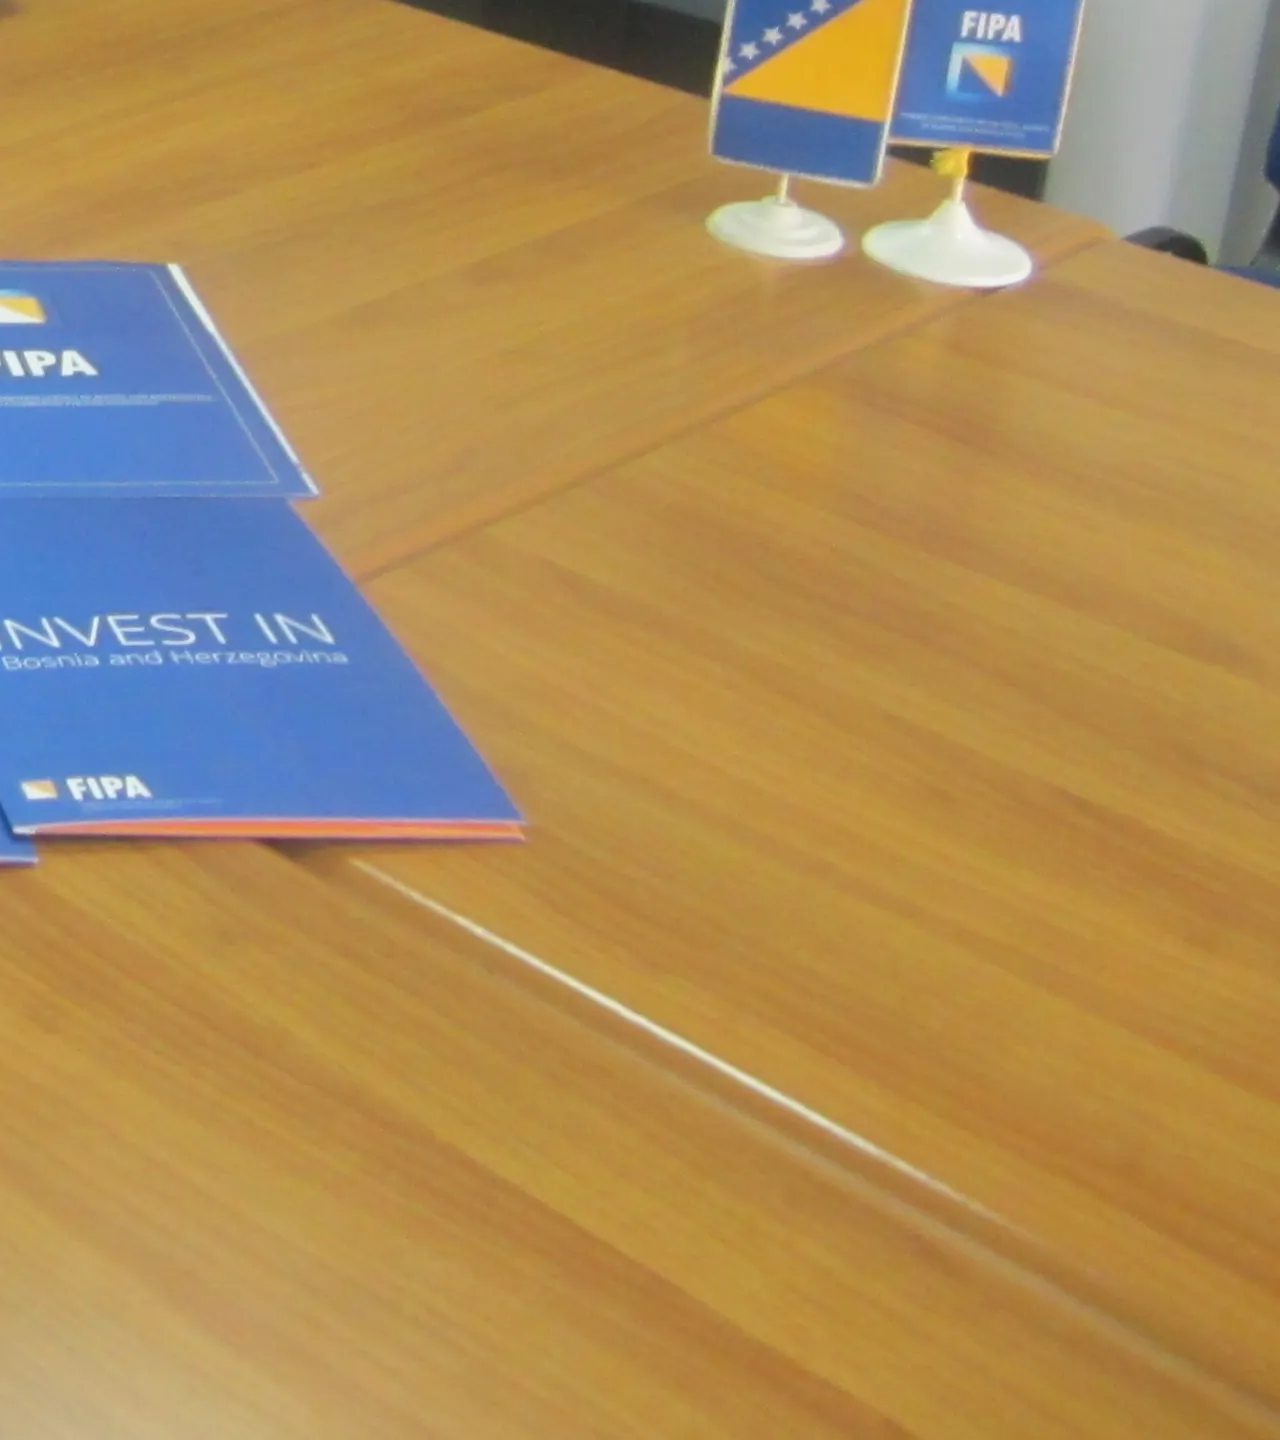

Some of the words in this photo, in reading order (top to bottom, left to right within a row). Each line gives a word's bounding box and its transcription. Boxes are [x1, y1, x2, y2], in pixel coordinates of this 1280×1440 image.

[960, 10, 1022, 43] FIPA
[253, 612, 335, 645] IN
[1, 651, 100, 671] Bosnia
[108, 649, 163, 667] and
[171, 648, 349, 669] Herzegovina
[65, 773, 153, 801] FIPA
